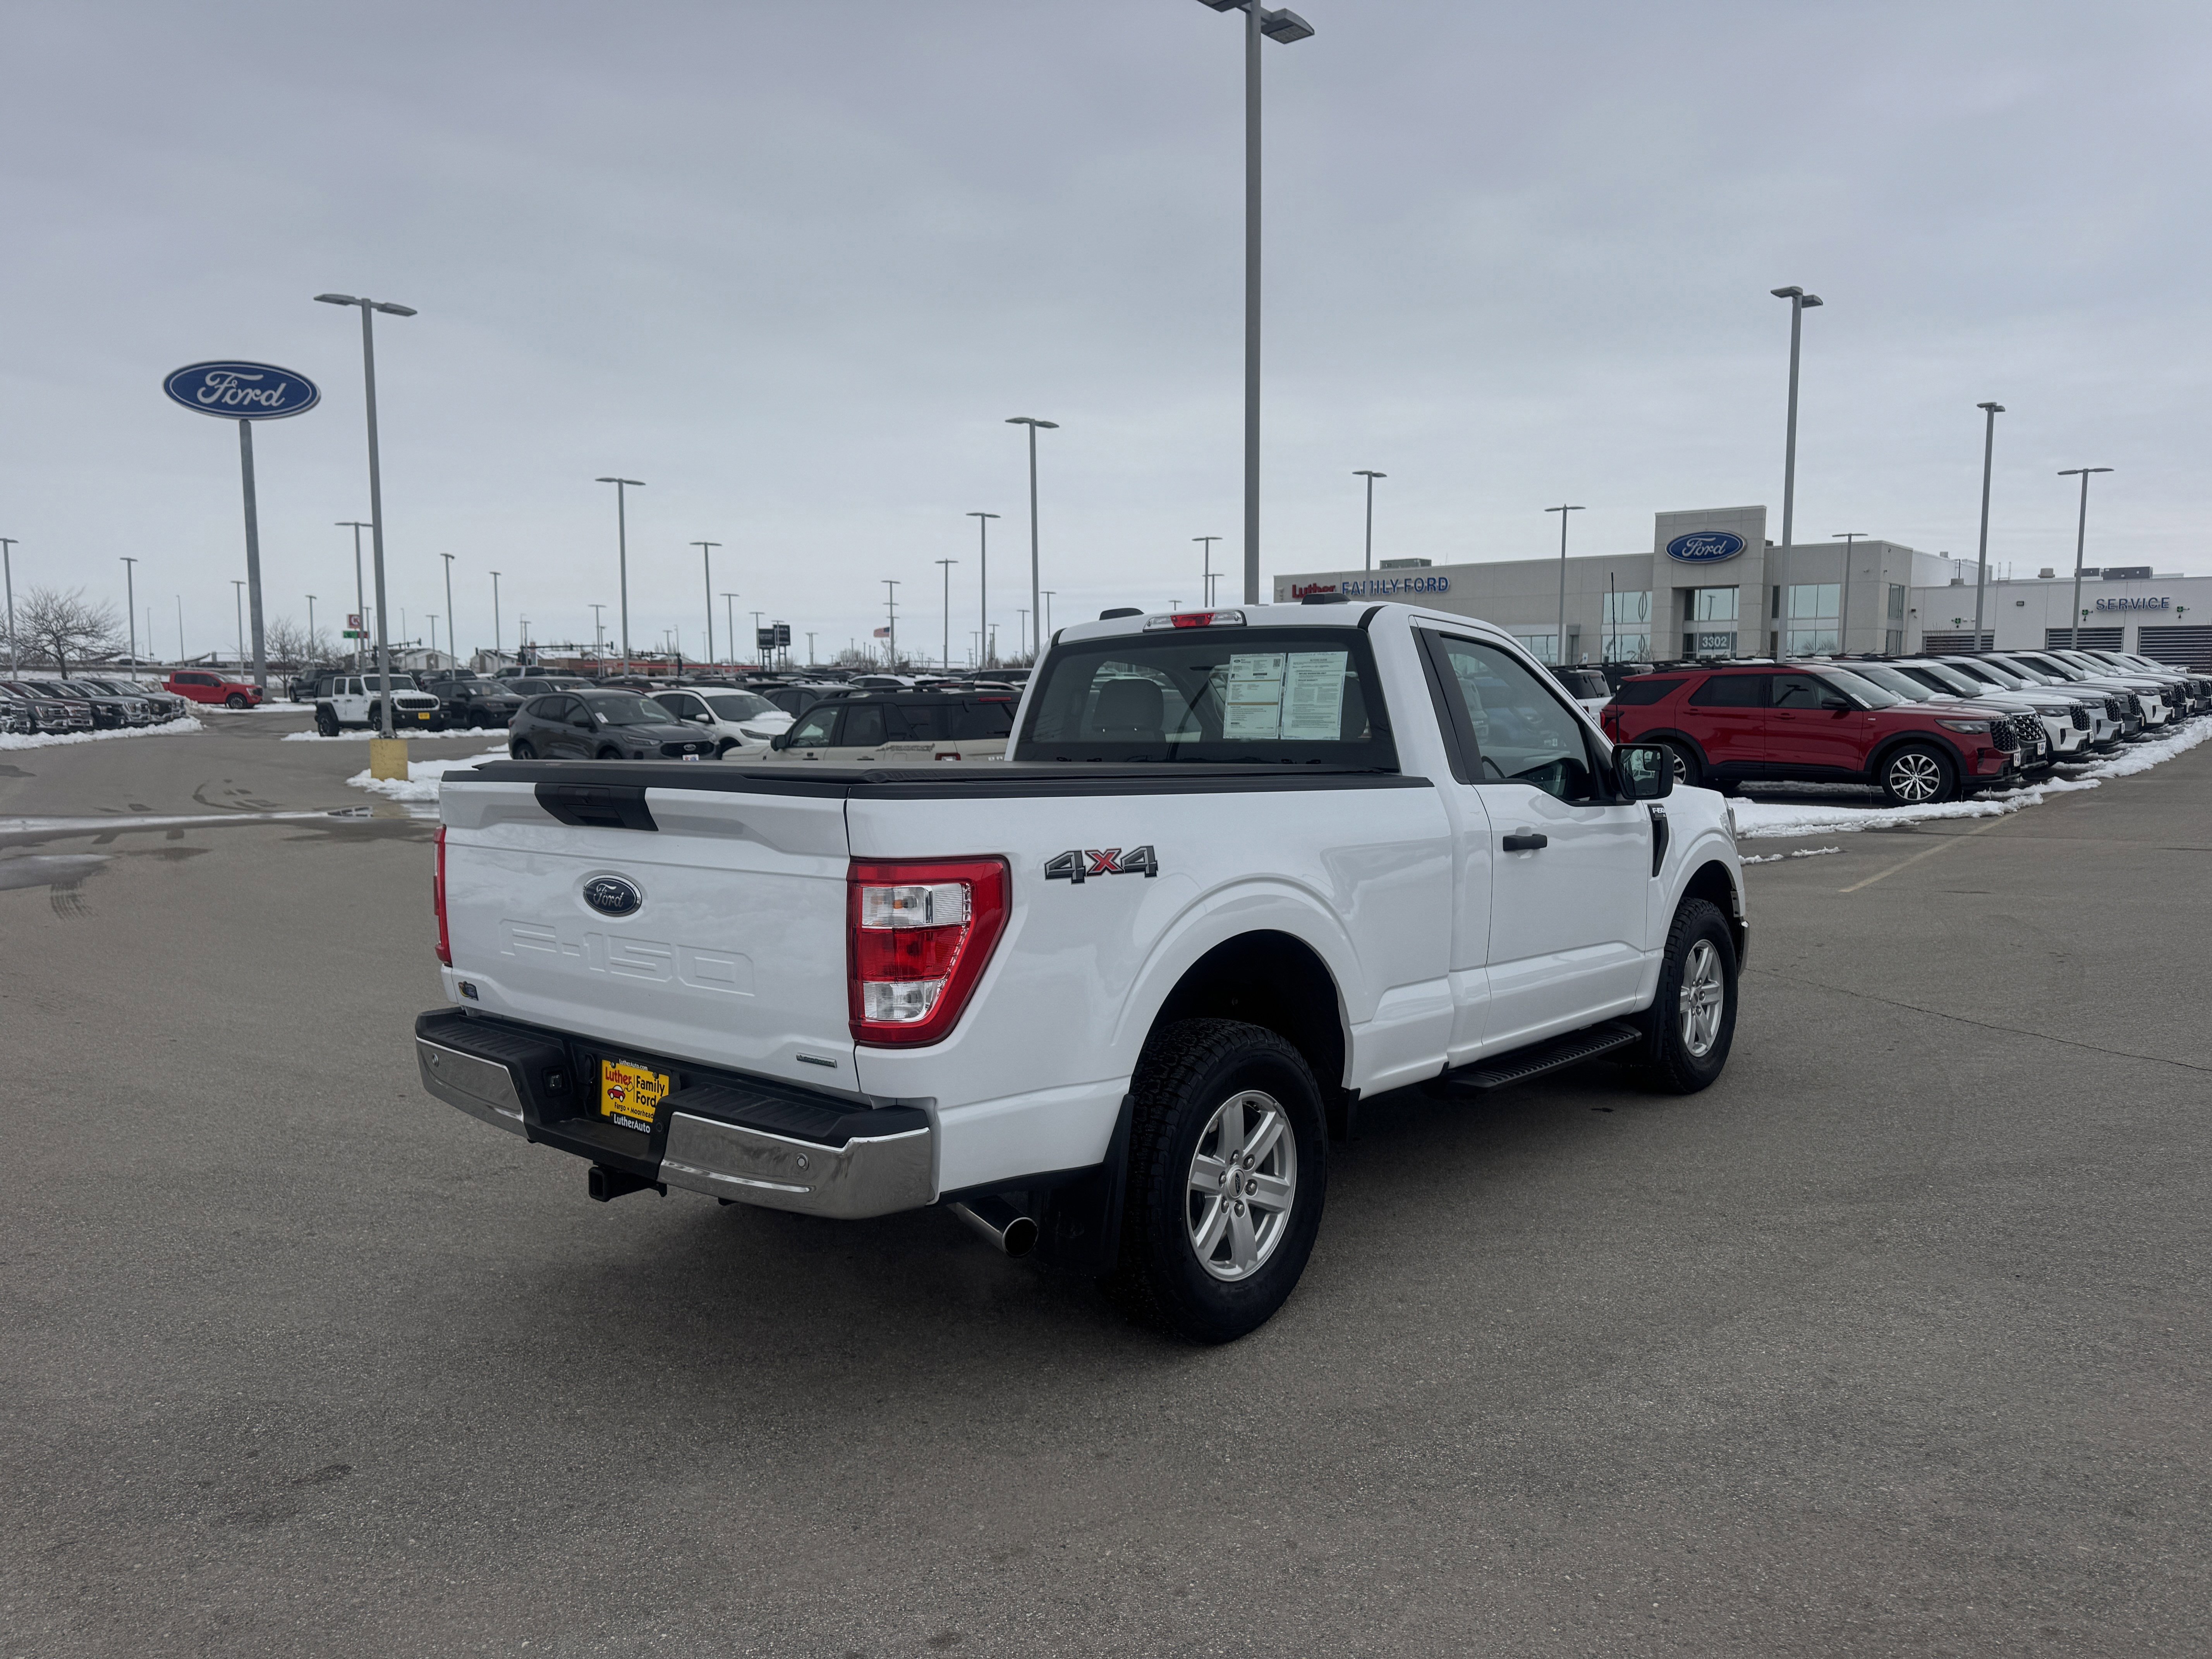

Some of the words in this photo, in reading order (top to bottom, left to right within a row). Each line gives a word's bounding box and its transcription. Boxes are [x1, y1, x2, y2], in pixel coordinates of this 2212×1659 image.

[197, 371, 287, 407] Ford
[1682, 537, 1727, 557] Ford
[1292, 583, 1336, 598] Luther
[1404, 577, 1449, 593] FORD
[2096, 597, 2170, 610] SERVICE
[1702, 636, 1727, 647] 3302
[593, 883, 624, 907] Ford
[499, 919, 755, 996] F-150
[619, 1059, 648, 1071] LutherAuto.com
[605, 1066, 632, 1085] Luther
[636, 1075, 665, 1097] Family
[636, 1091, 656, 1108] Ford
[615, 1102, 626, 1111] Fargo
[630, 1107, 654, 1119] Moorhead
[614, 1113, 651, 1133] LutherAuto
